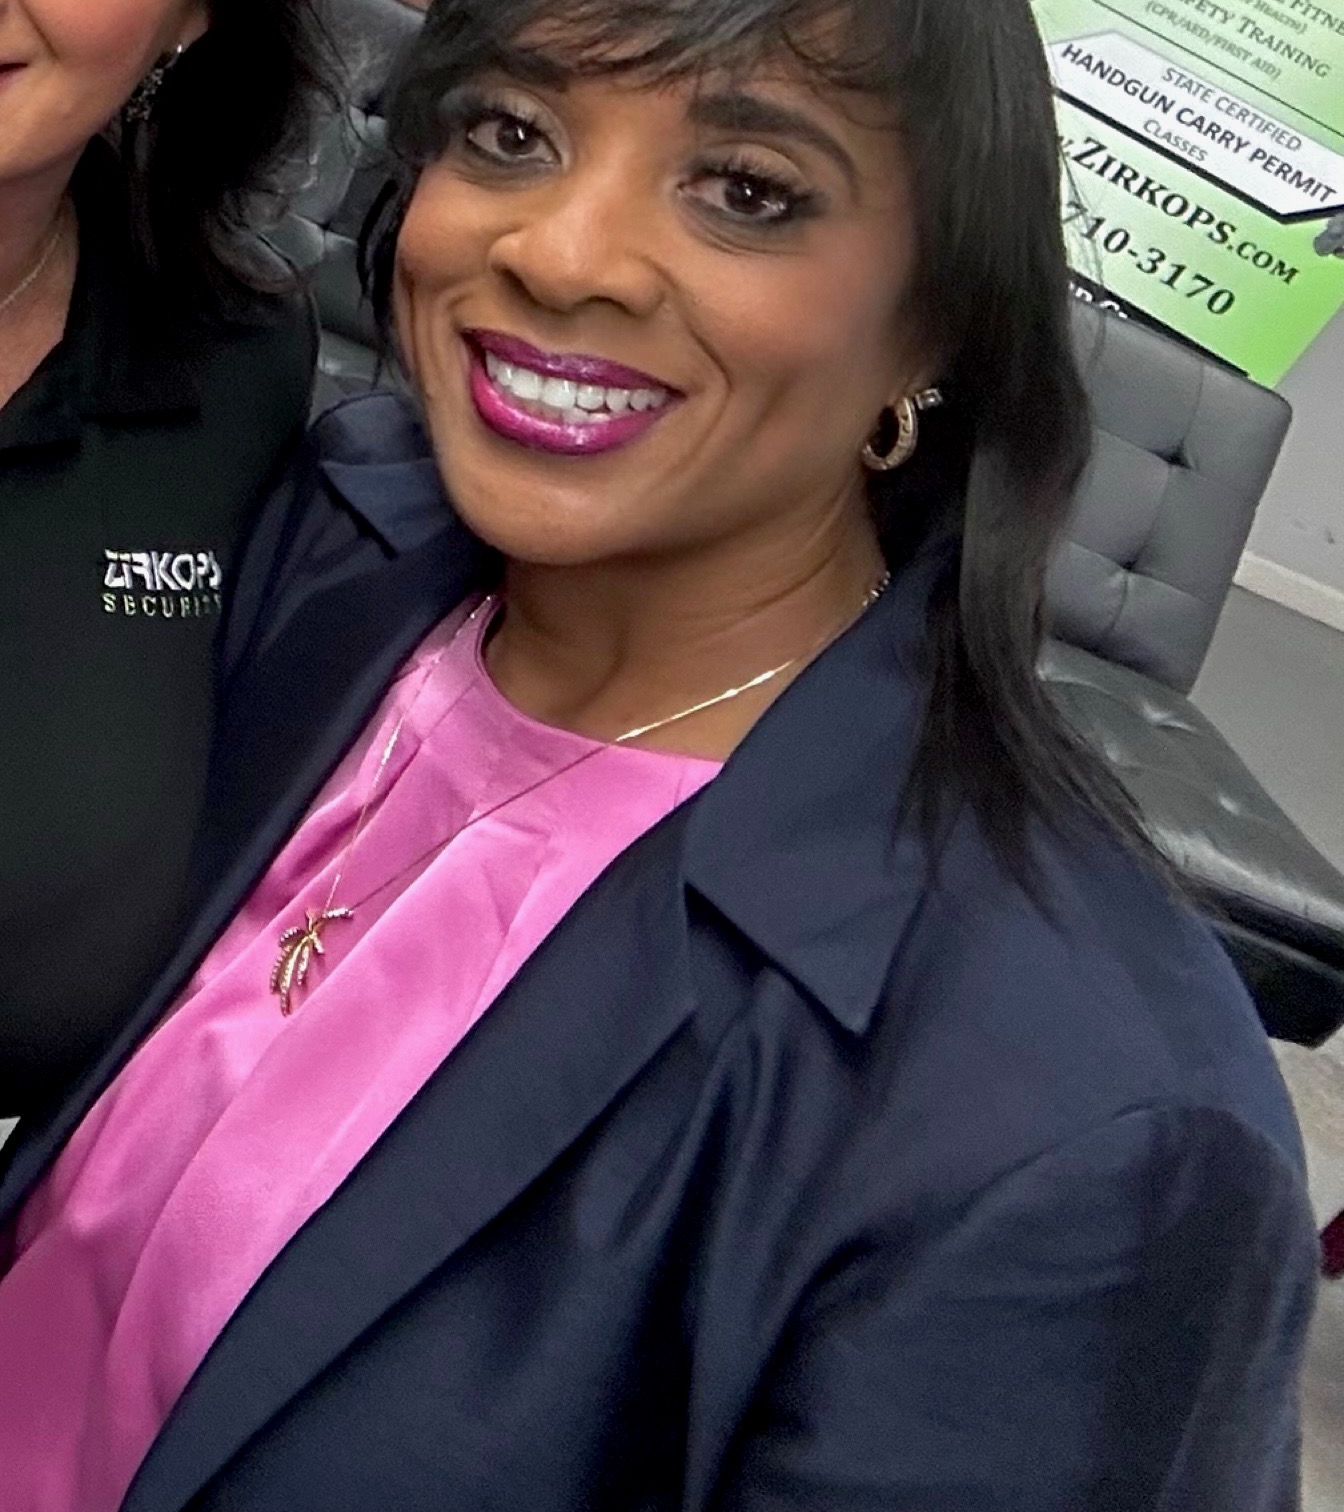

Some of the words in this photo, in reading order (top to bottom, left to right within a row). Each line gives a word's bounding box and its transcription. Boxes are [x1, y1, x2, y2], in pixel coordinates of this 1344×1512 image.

[1234, 16, 1333, 79] TRAINING
[1060, 44, 1175, 114] HANDGUN
[1174, 106, 1250, 157] CARRY
[1248, 147, 1336, 204] PERMIT
[1142, 117, 1209, 162] CLASSES
[1162, 67, 1213, 103] STATE
[1213, 96, 1303, 152] CERTIFIED
